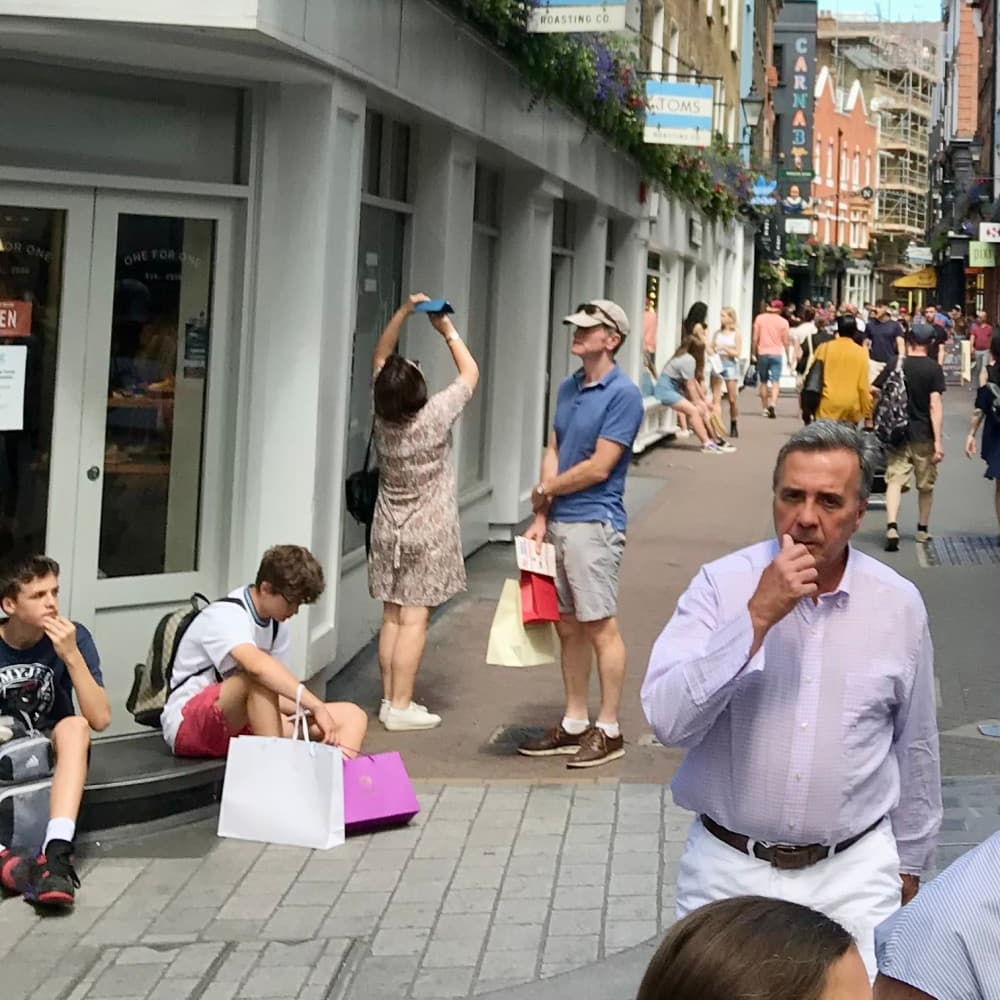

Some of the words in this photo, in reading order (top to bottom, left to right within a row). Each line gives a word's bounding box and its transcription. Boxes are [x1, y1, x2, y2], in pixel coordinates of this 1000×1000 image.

[540, 15, 592, 25] ROASTING
[658, 96, 701, 114] TOMS
[124, 250, 148, 265] ONE
[151, 249, 176, 261] FOR
